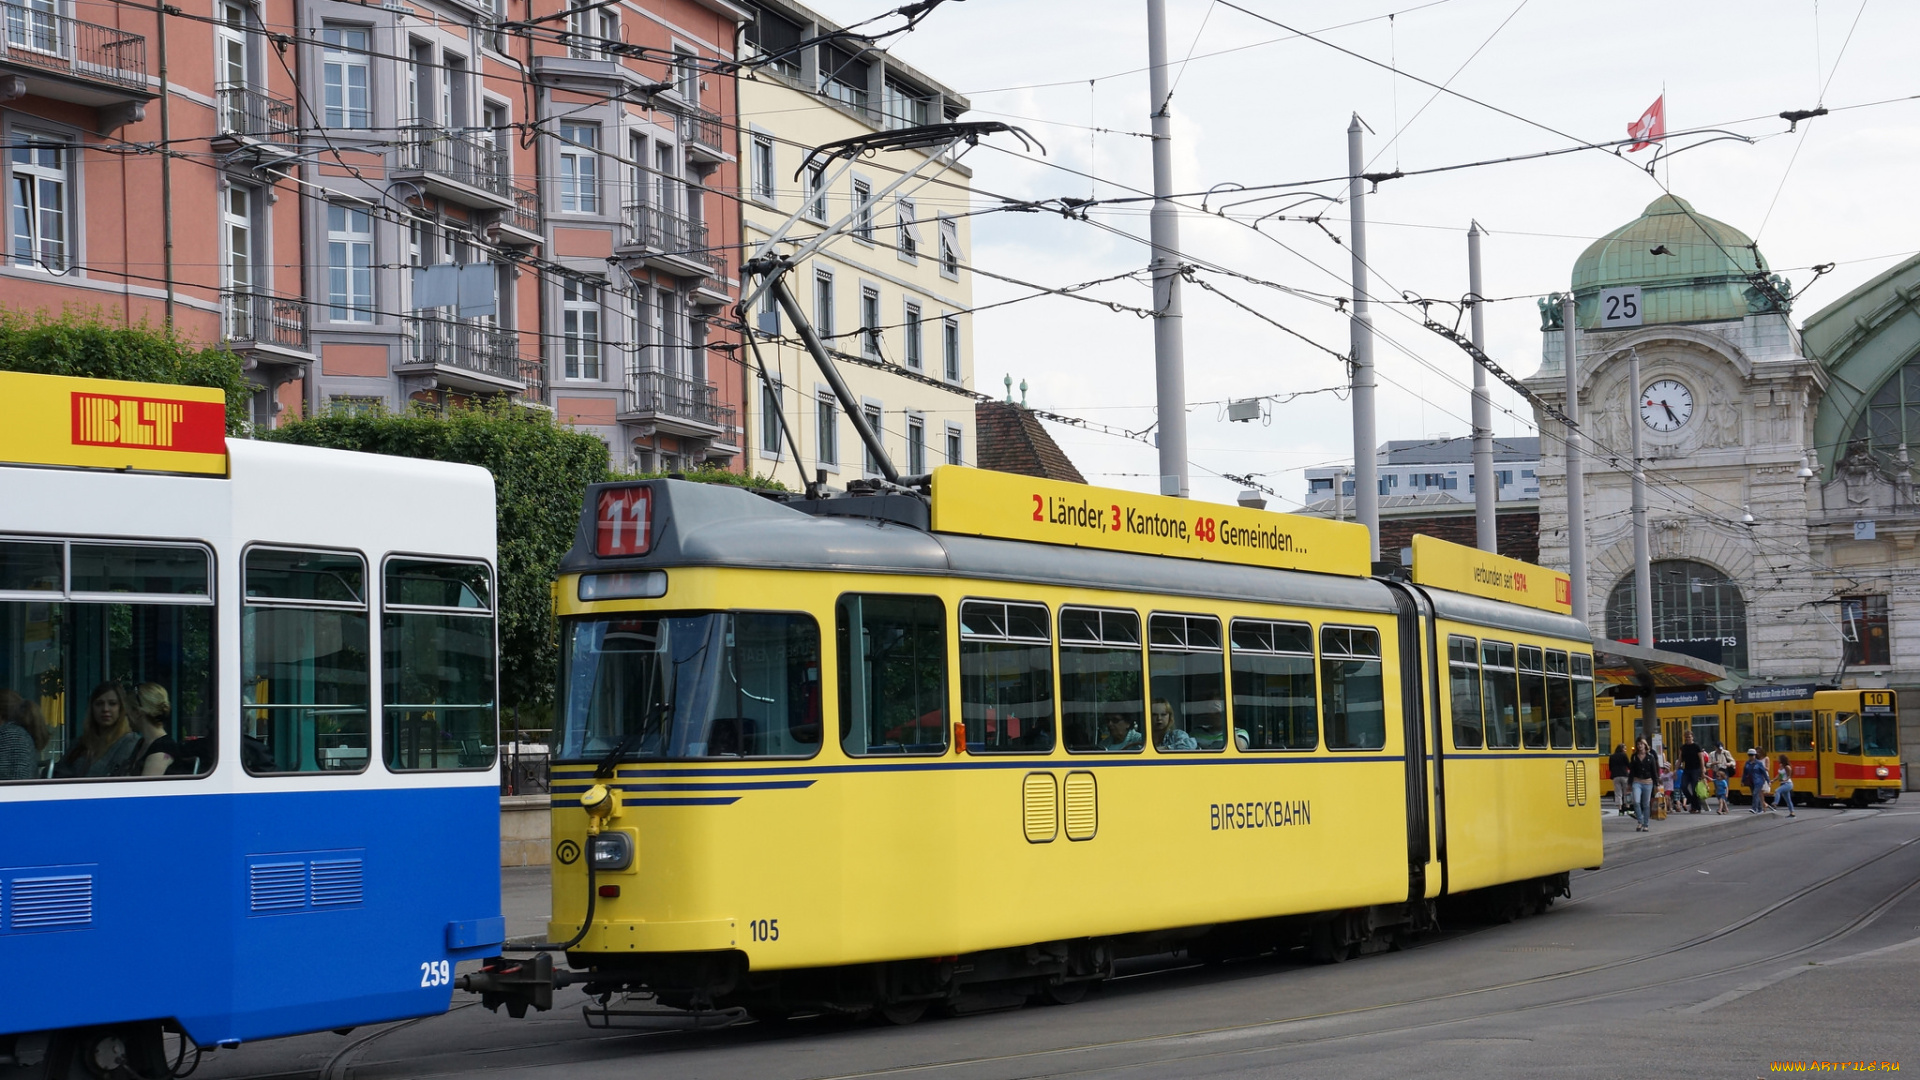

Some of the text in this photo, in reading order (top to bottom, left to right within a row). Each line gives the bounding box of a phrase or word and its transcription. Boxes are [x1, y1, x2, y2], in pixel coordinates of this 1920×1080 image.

[1606, 294, 1637, 321] 25
[79, 396, 183, 447] BLT
[607, 498, 647, 548] 11
[1032, 494, 1044, 522] 2
[1049, 496, 1107, 533] Länder,
[1111, 505, 1121, 531] 3
[1126, 507, 1191, 543] Kantone,
[1194, 516, 1216, 543] 48
[1473, 562, 1503, 588] verbunden
[1504, 569, 1513, 590] seit
[1870, 693, 1884, 705] 10
[1210, 800, 1311, 830] BIRSECKBAHN
[750, 918, 779, 942] 105
[420, 959, 450, 988] 259
